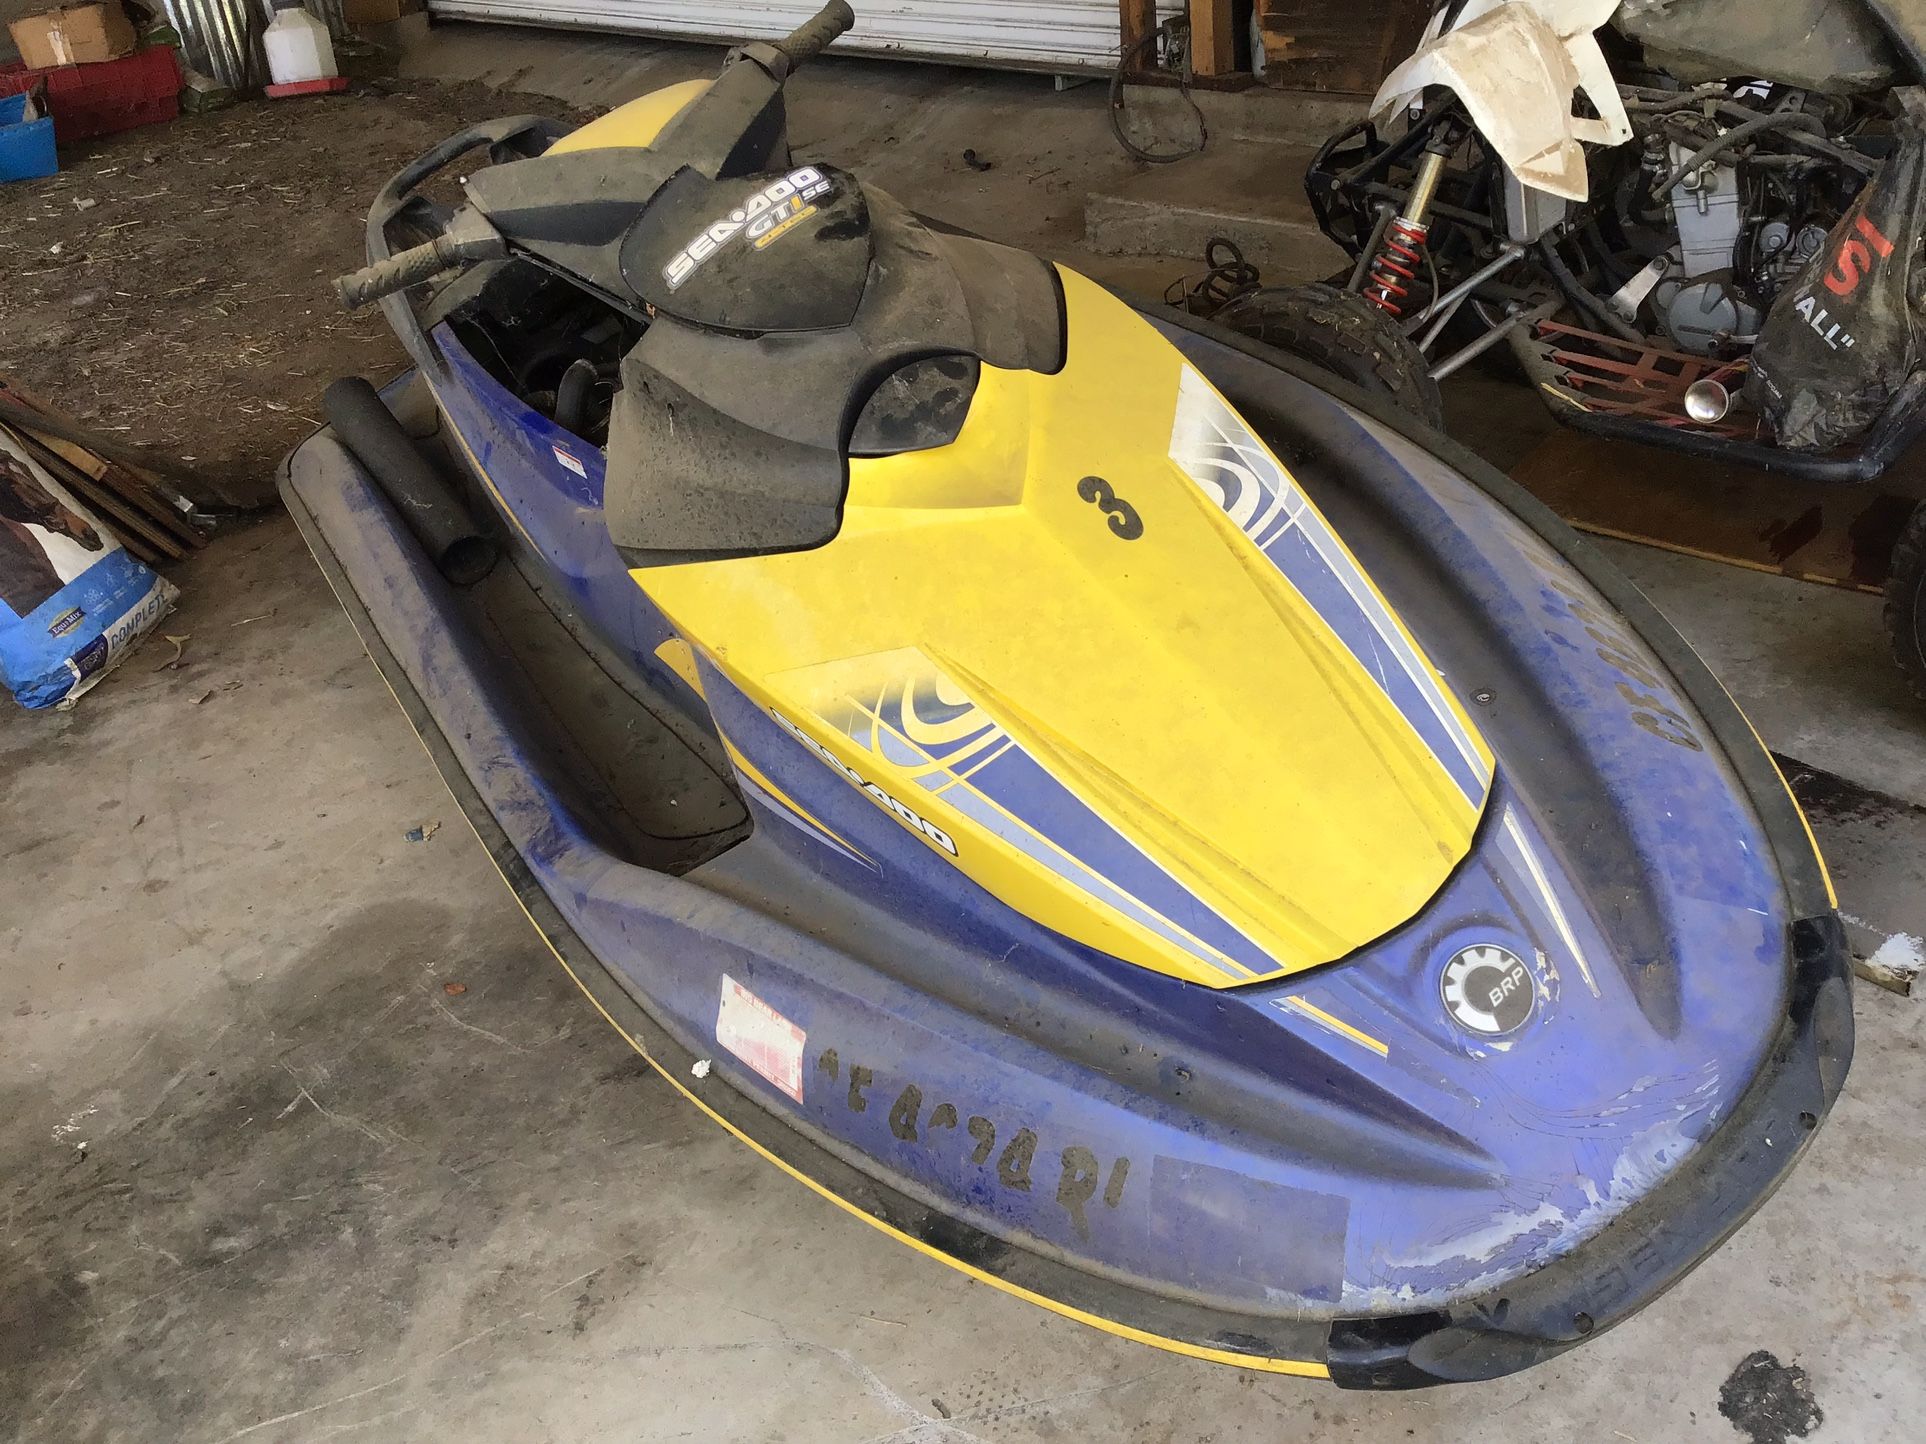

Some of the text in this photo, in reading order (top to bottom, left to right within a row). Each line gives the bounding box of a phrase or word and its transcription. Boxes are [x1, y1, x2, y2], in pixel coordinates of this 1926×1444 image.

[802, 180, 831, 200] SE
[1077, 476, 1144, 540] 3
[1488, 966, 1524, 1007] BRP
